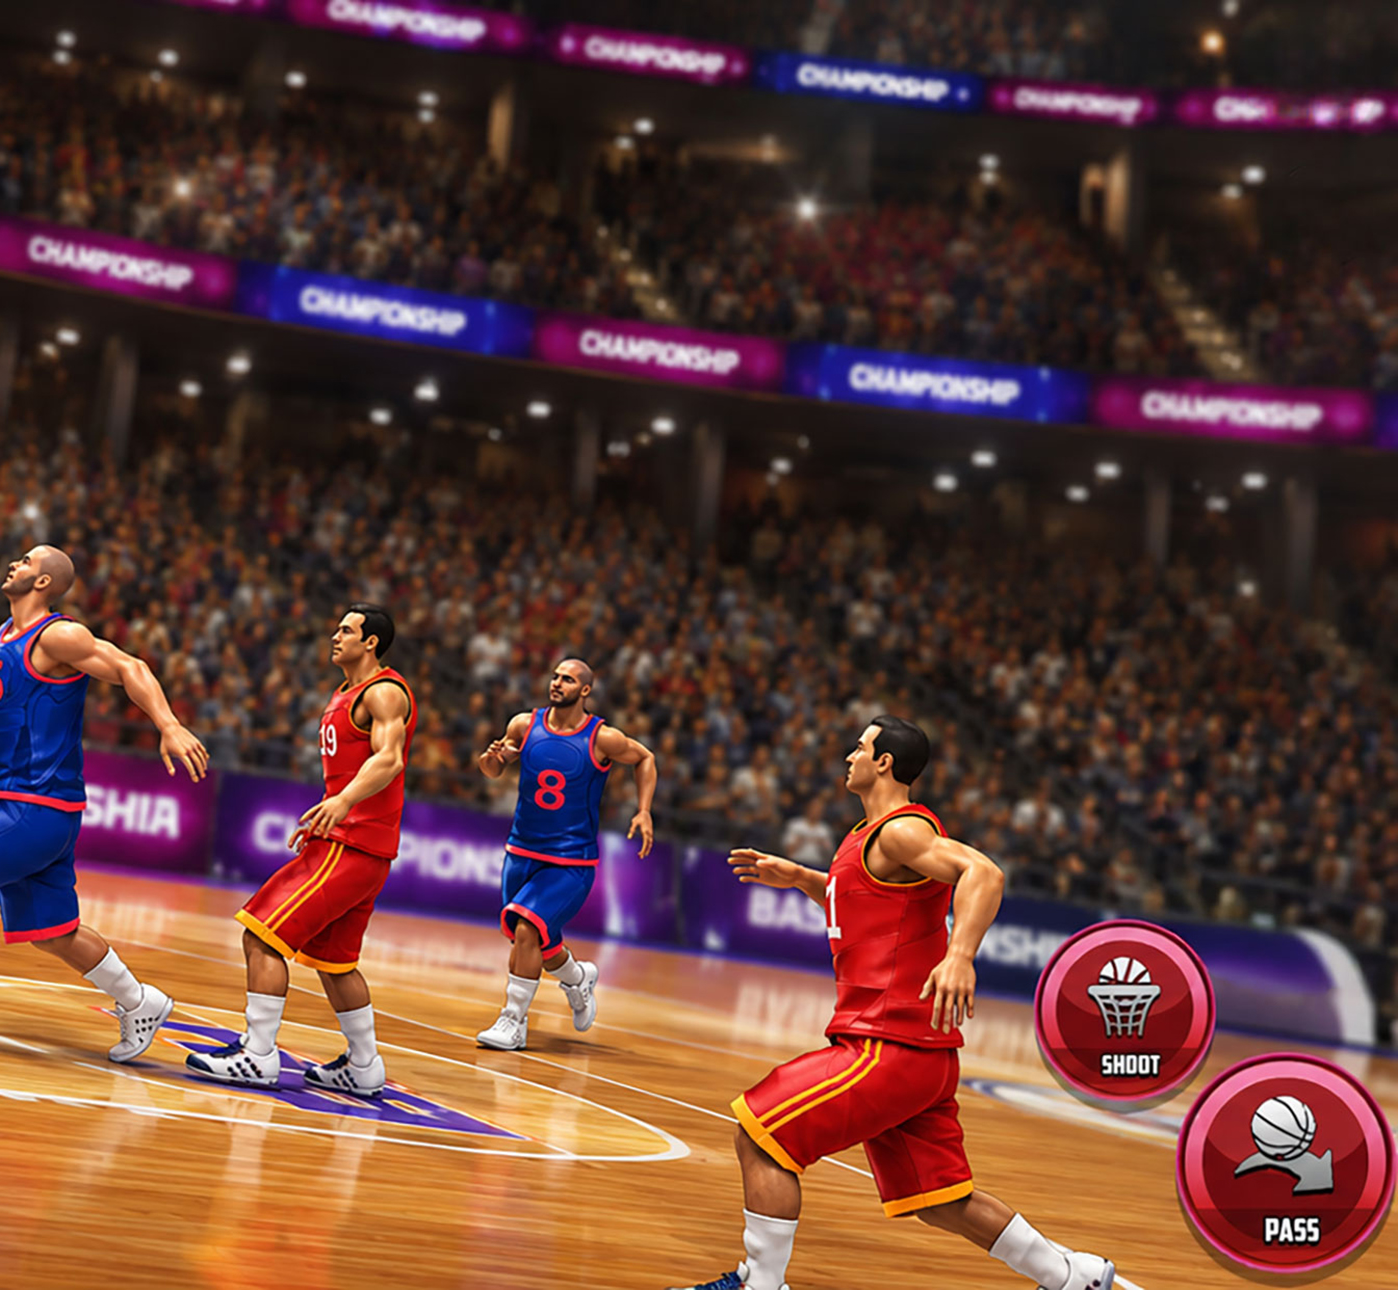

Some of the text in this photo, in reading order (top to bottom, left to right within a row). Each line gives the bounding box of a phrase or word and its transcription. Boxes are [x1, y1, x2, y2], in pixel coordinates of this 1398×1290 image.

[28, 235, 194, 290] CHAMPIONSHIP
[299, 285, 467, 336] CHAMPIONSHIP
[579, 329, 740, 374] CHAMPIONSHIP
[848, 362, 1021, 406] CHAMPIONSHIP
[1141, 391, 1323, 430] CHAMPIONSHIP
[534, 769, 566, 811] 8
